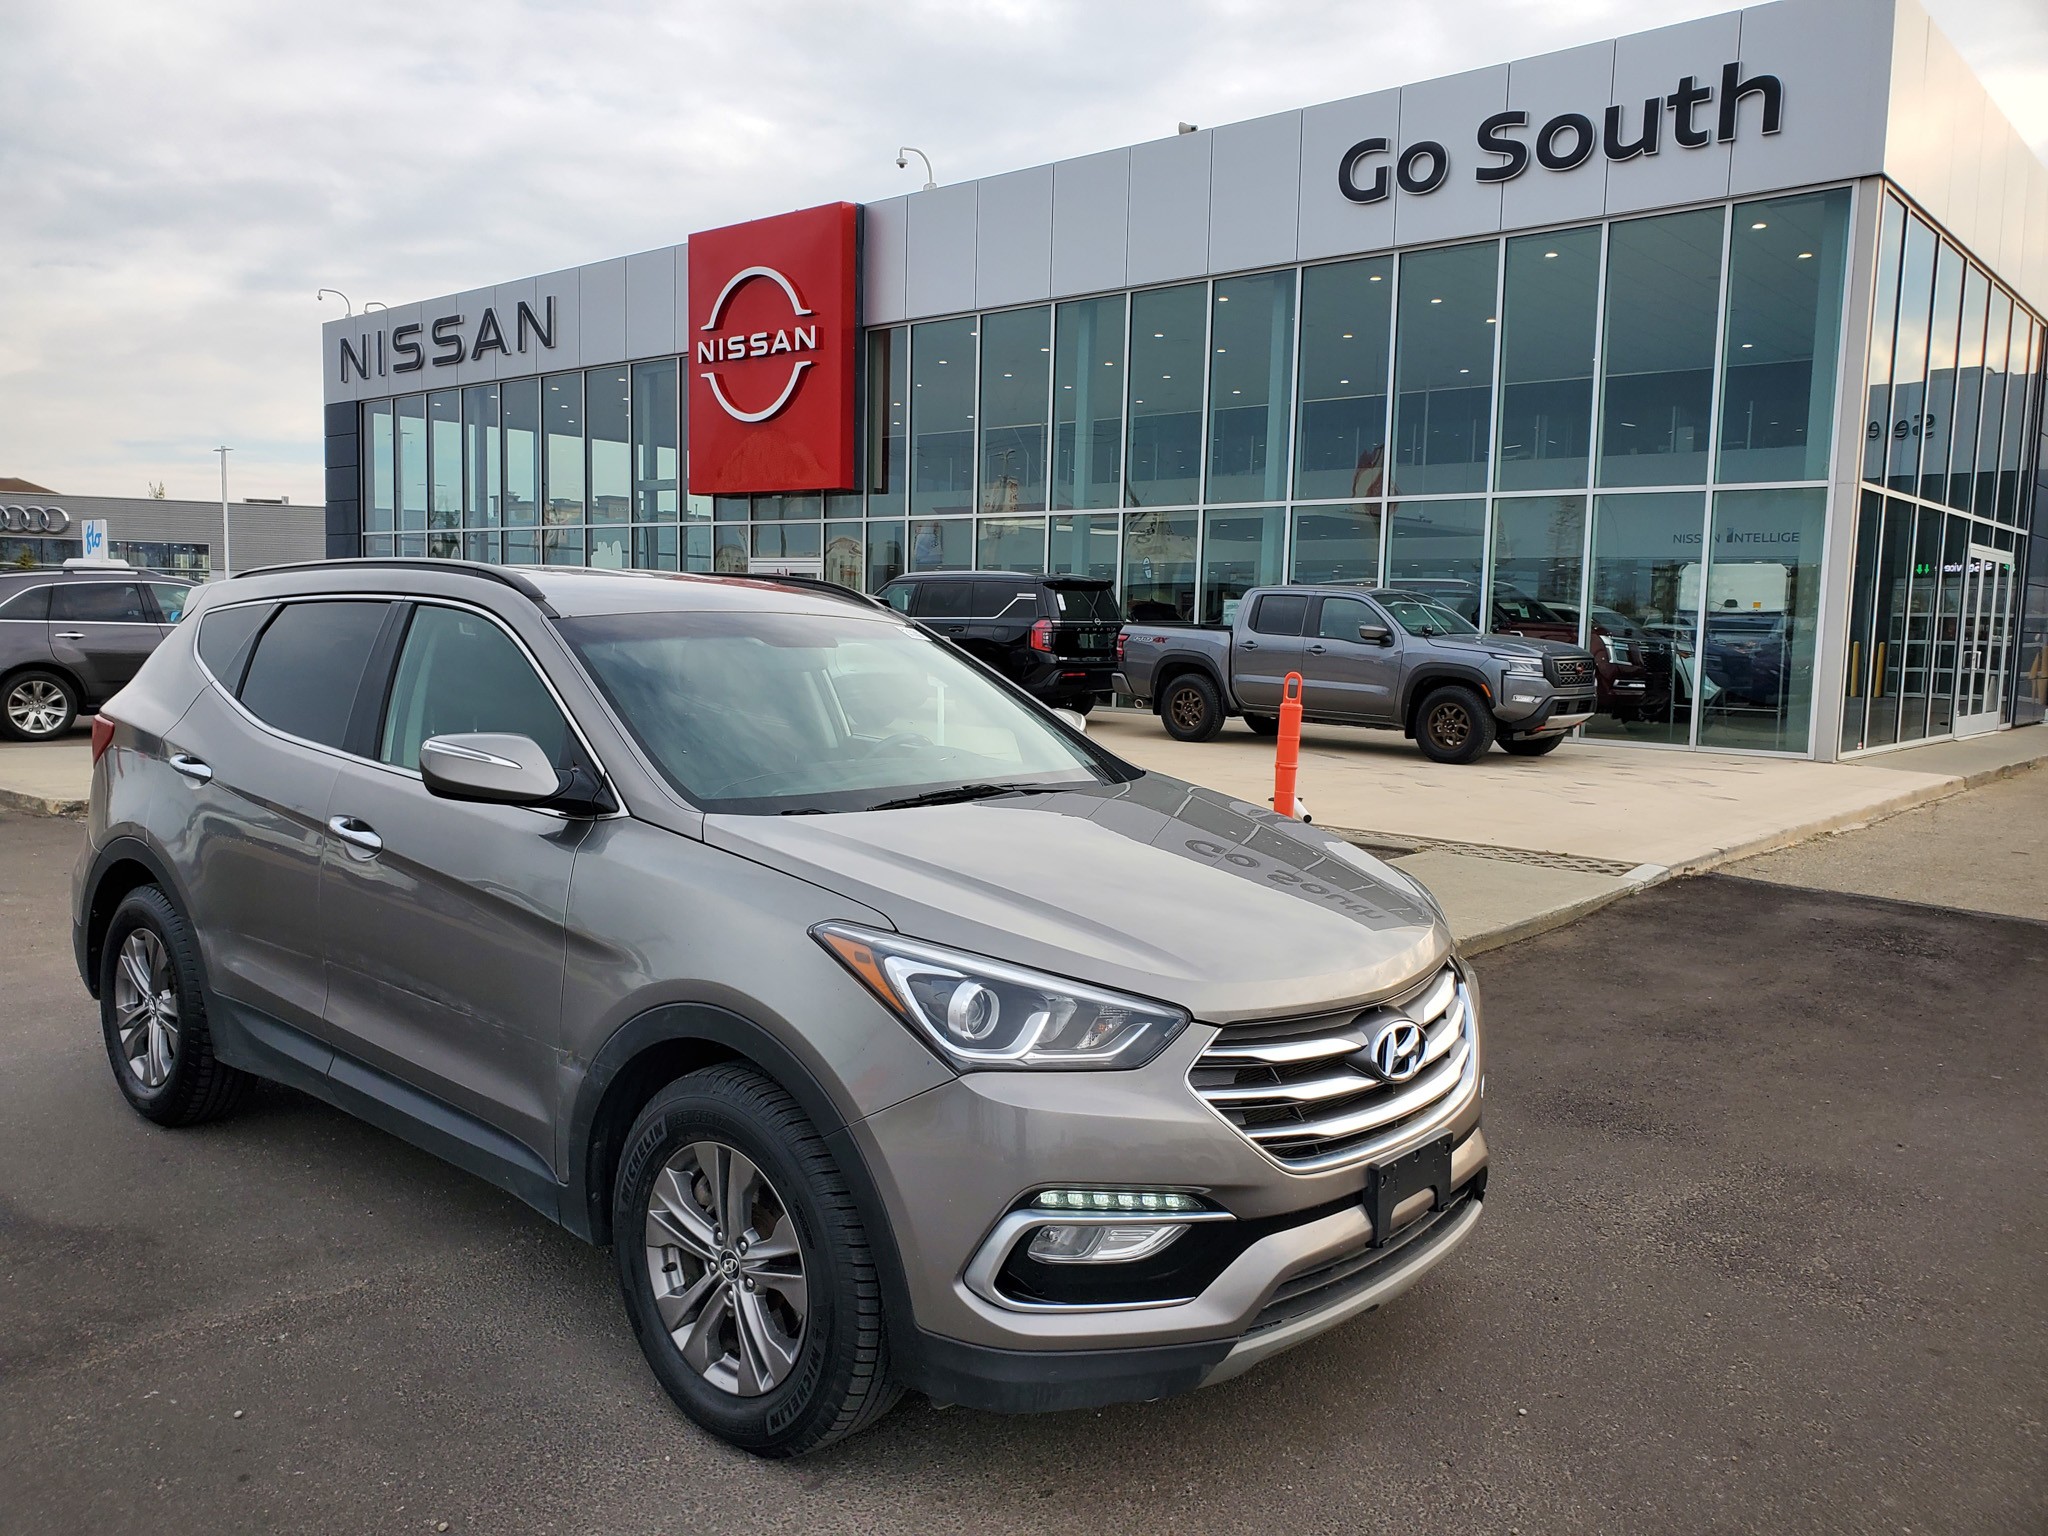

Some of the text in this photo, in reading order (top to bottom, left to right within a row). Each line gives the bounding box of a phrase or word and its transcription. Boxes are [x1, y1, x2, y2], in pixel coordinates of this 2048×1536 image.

[1338, 61, 1784, 203] Go South
[340, 295, 556, 383] NISSAN
[697, 325, 816, 363] NISSAN
[86, 520, 102, 555] flo
[1673, 533, 1720, 544] NISSN
[620, 1119, 666, 1204] MICHELIN
[769, 1345, 821, 1431] MICHELIN
